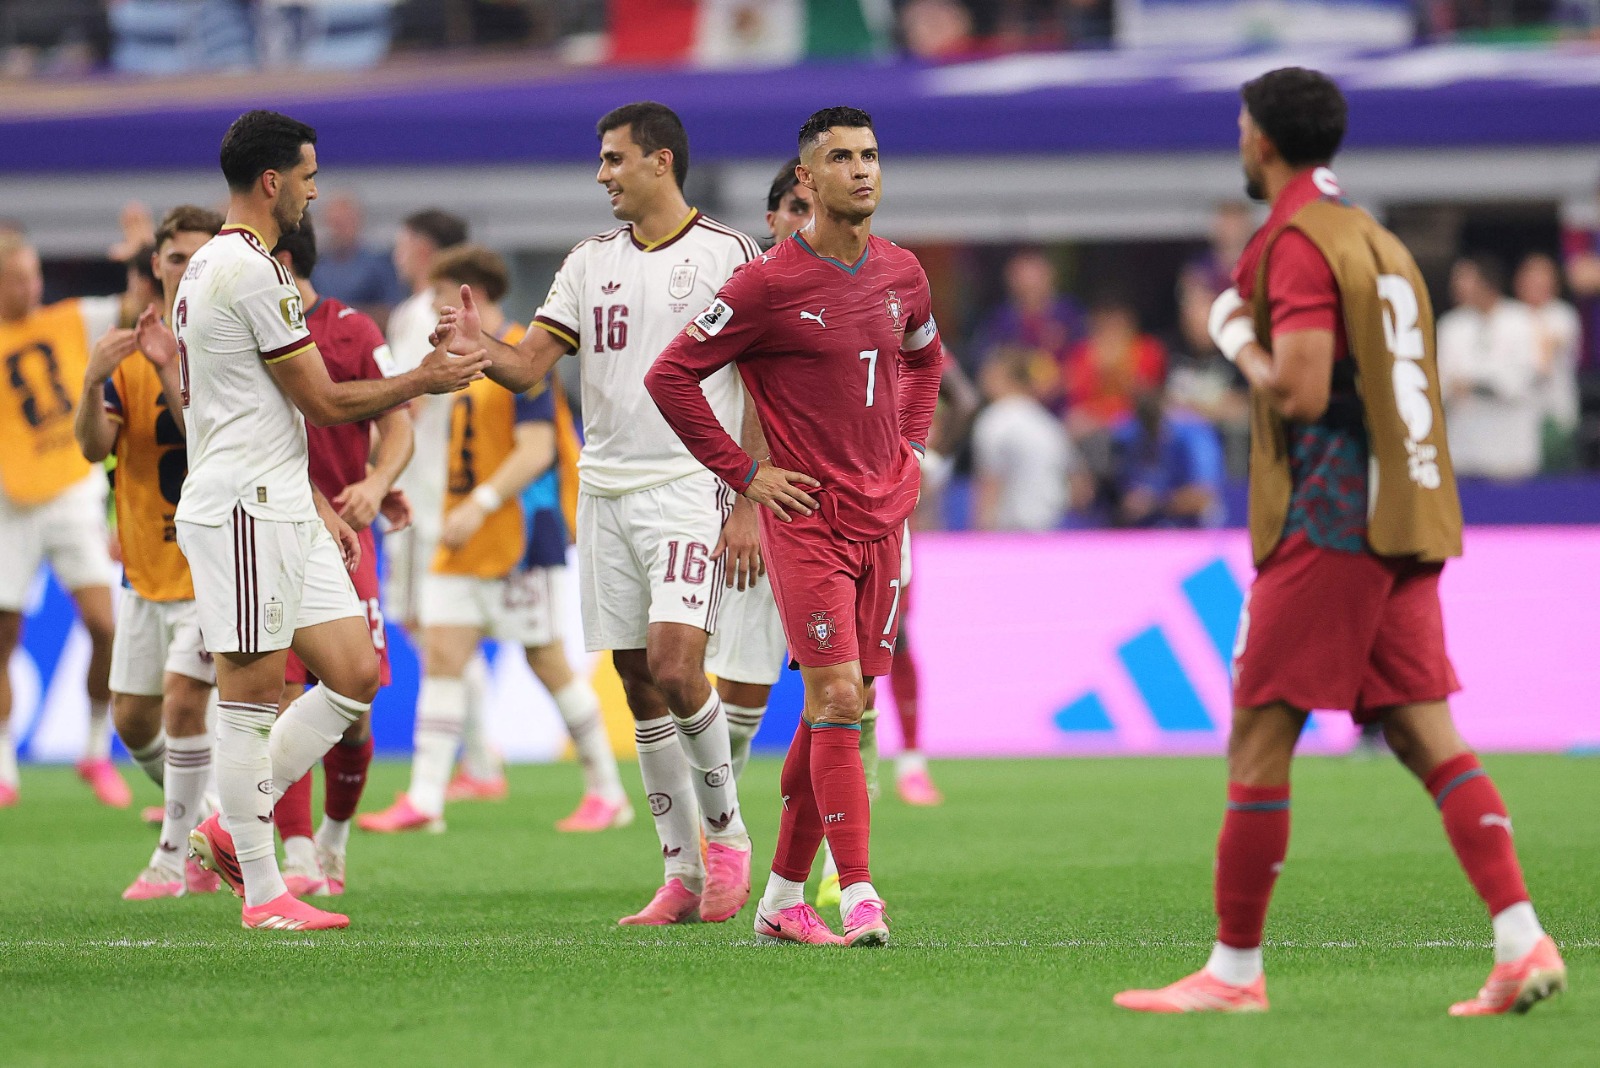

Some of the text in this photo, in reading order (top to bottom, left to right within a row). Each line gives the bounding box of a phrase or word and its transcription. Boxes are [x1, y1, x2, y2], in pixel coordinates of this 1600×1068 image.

[593, 303, 629, 353] 16
[859, 348, 879, 408] 7
[663, 540, 709, 585] 16
[882, 578, 900, 635] 7
